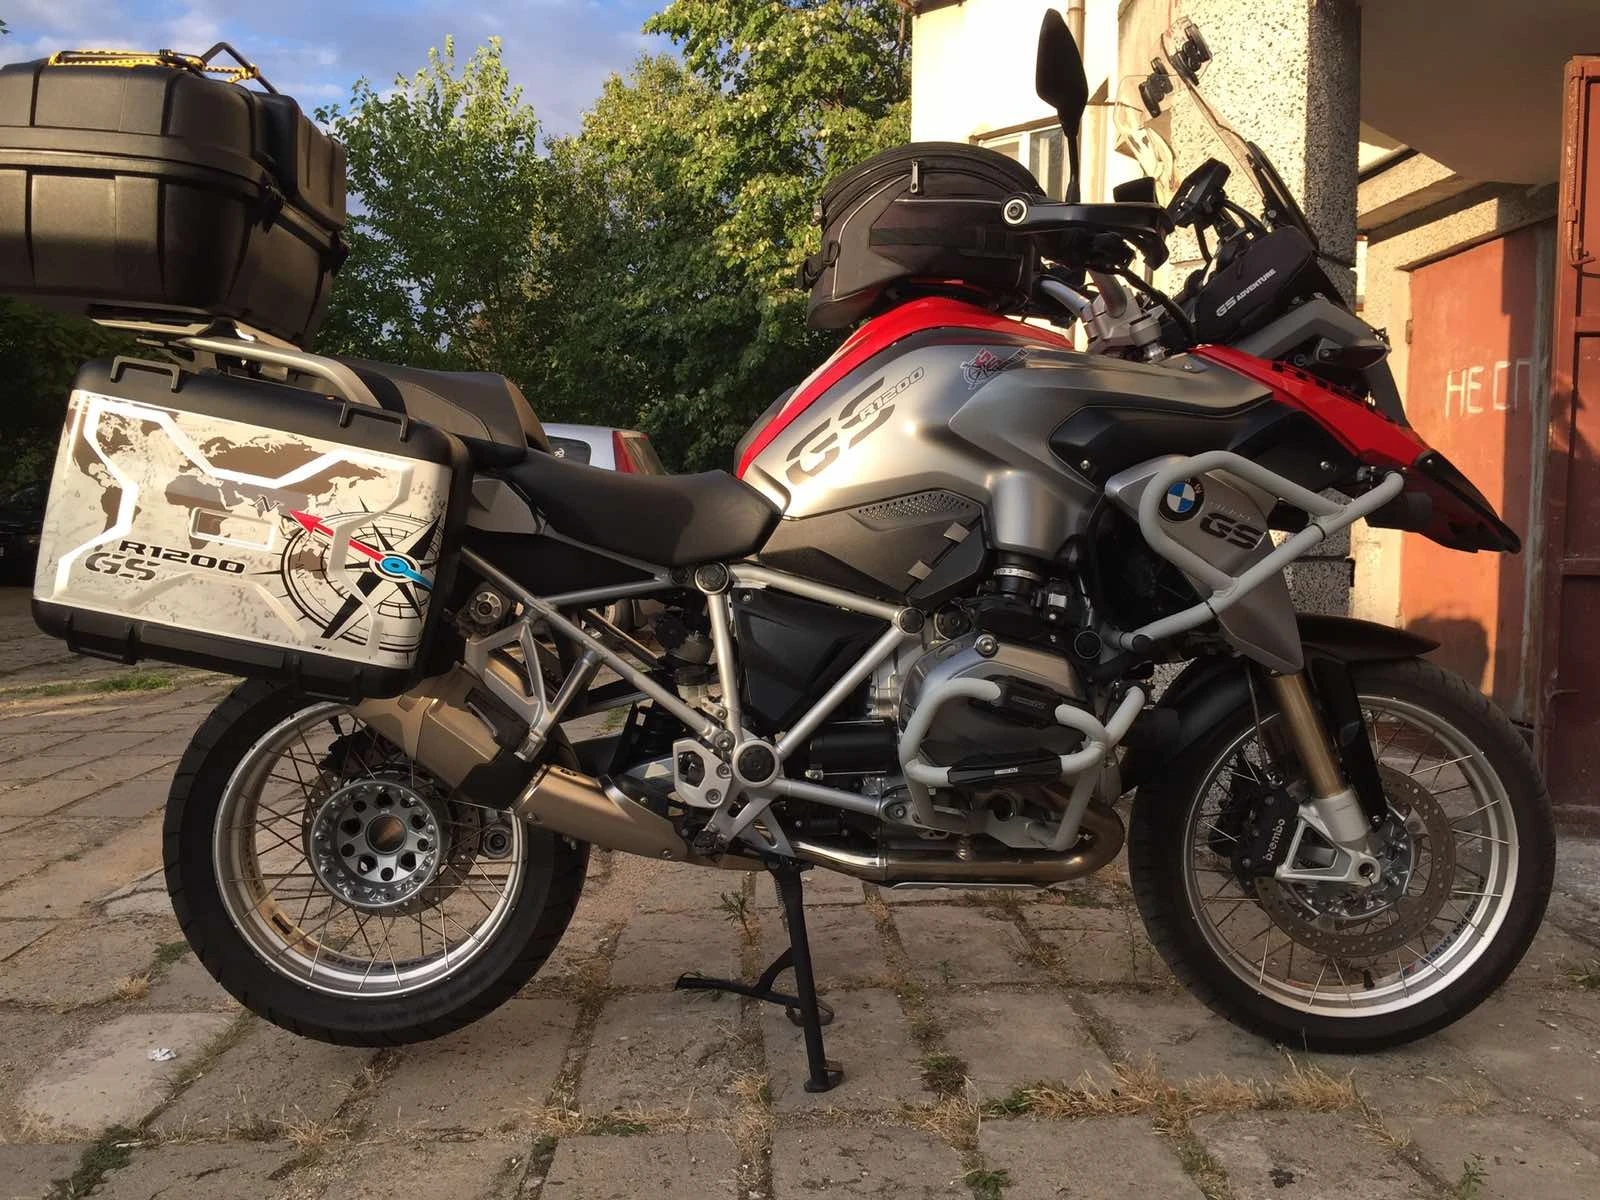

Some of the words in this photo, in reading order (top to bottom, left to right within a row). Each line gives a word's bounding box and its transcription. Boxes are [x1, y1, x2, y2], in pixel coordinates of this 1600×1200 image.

[1215, 296, 1237, 317] GS
[1236, 268, 1277, 301] ADVENTURE
[859, 366, 925, 422] R1200
[785, 376, 896, 486] GS
[1200, 512, 1265, 549] GS
[84, 551, 162, 582] GS
[118, 539, 246, 575] R1200
[1262, 818, 1286, 862] brembo
